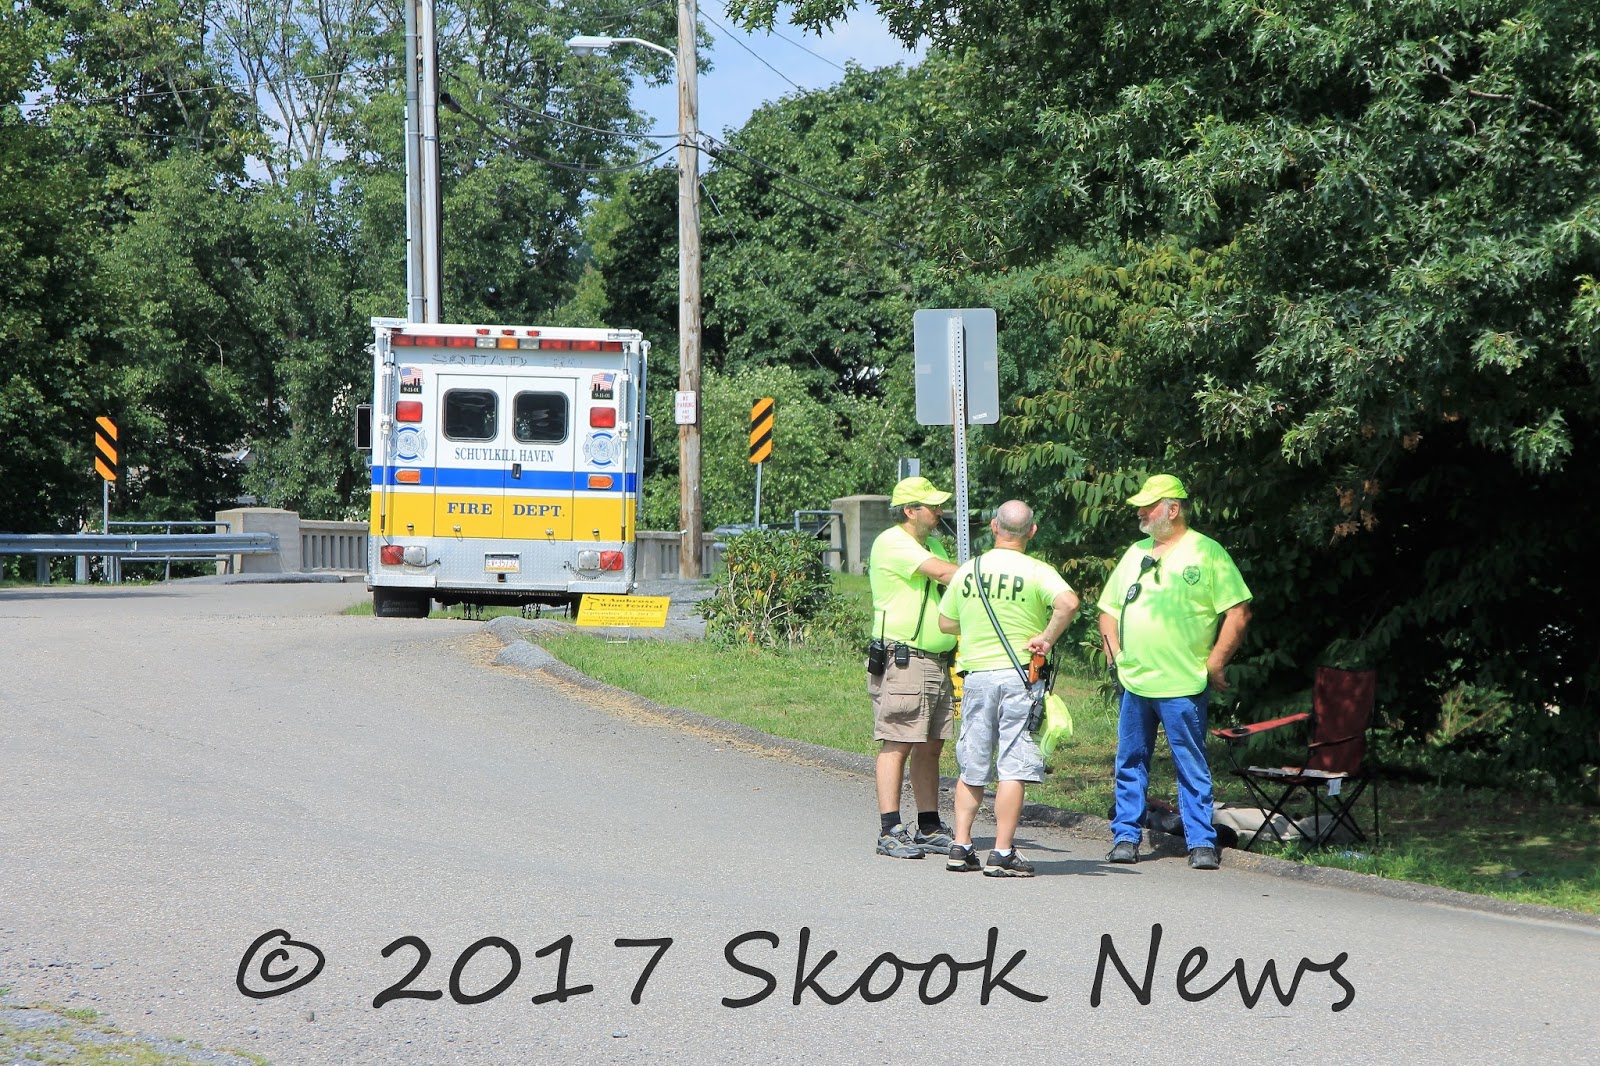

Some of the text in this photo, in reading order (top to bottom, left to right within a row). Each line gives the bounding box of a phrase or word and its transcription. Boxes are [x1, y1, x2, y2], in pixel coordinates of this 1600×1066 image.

[454, 447, 554, 462] SCHUYLKILL HAVEN
[447, 502, 565, 517] FIRE DEPT.
[962, 573, 1026, 602] S.H.F.P.
